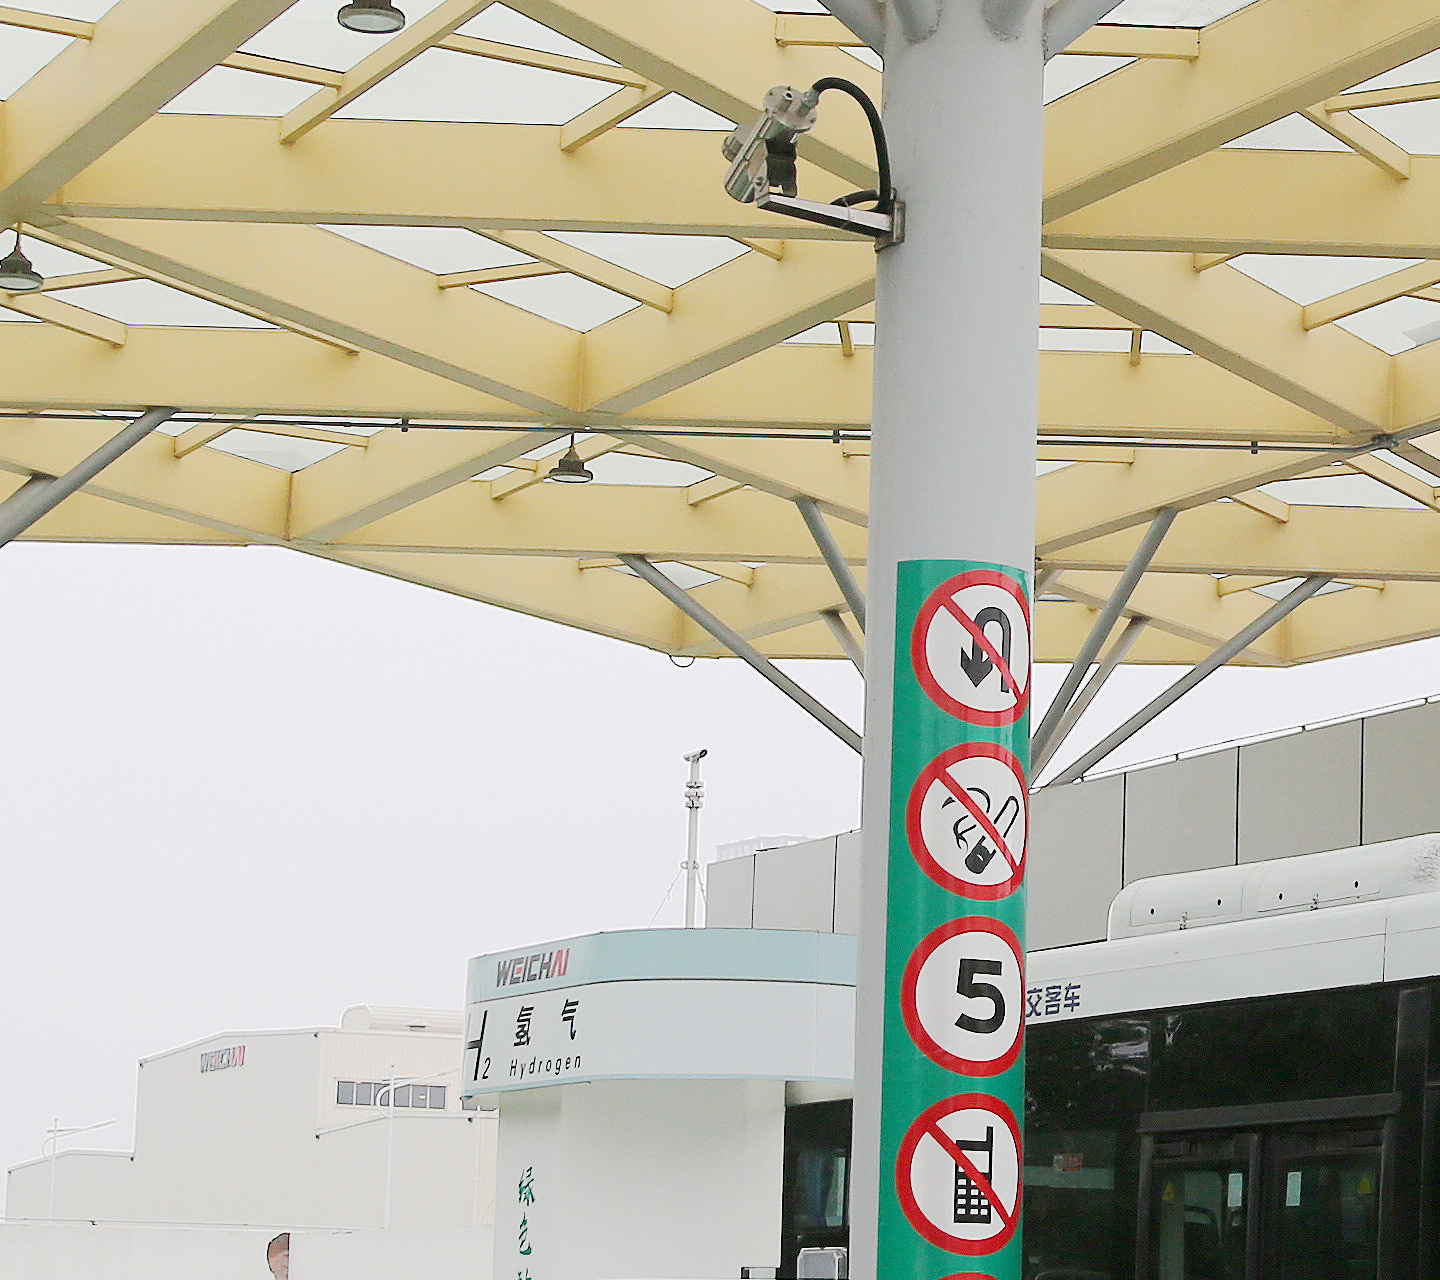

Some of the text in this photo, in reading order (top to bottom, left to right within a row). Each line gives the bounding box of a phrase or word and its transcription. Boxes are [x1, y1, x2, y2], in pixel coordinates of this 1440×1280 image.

[497, 948, 570, 988] WEICHAI
[954, 958, 1006, 1034] 5
[513, 999, 579, 1047] 氢气
[509, 1055, 581, 1080] Hydrogen
